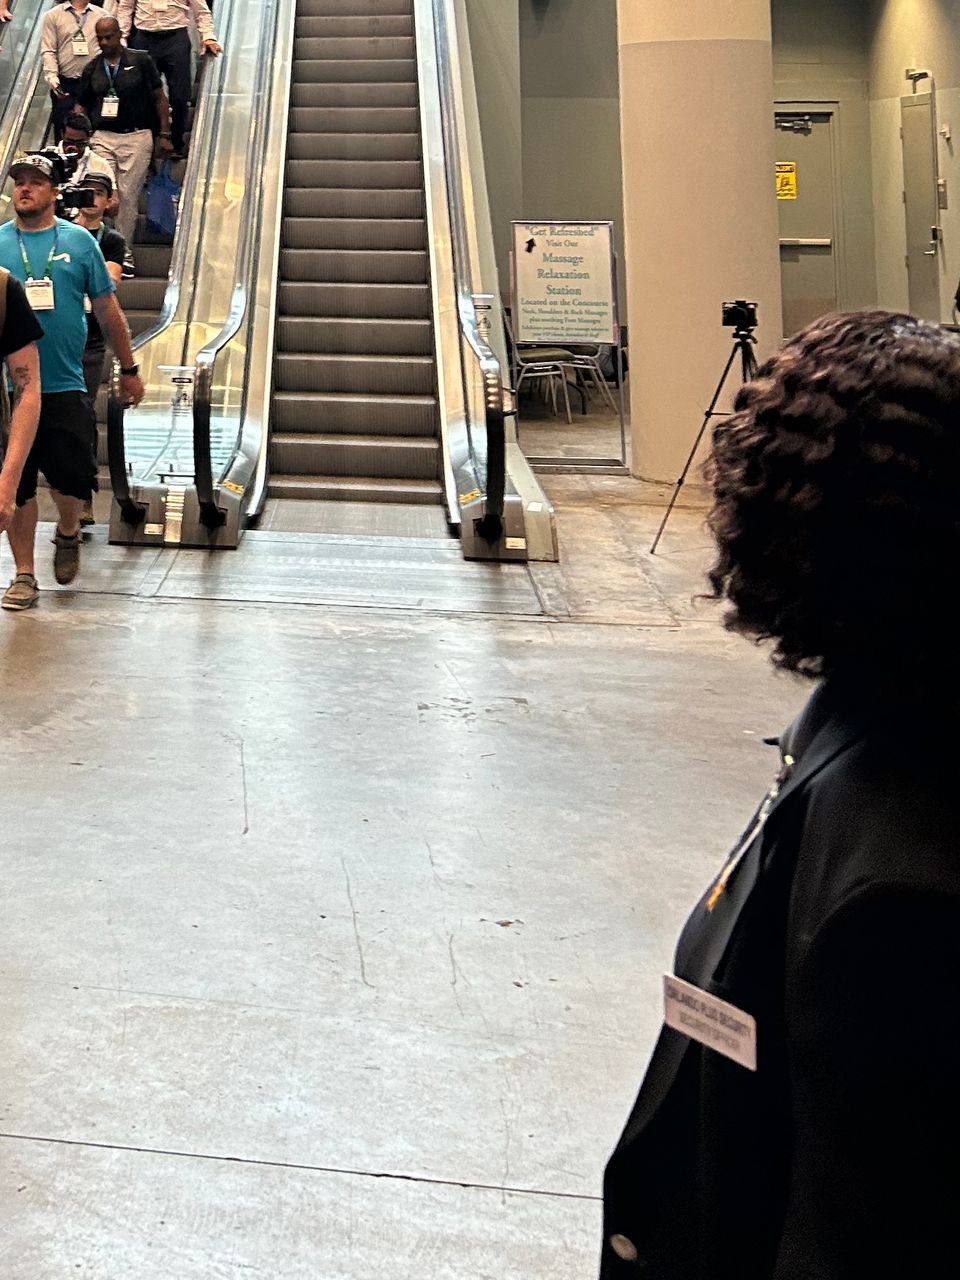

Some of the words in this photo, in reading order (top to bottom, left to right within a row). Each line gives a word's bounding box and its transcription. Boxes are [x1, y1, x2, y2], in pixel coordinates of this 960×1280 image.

[546, 239, 563, 247] Visit
[543, 253, 584, 266] Massage
[537, 268, 590, 279] Relaxation
[546, 284, 582, 295] Station
[559, 298, 571, 306] the
[572, 298, 609, 307] Concourse
